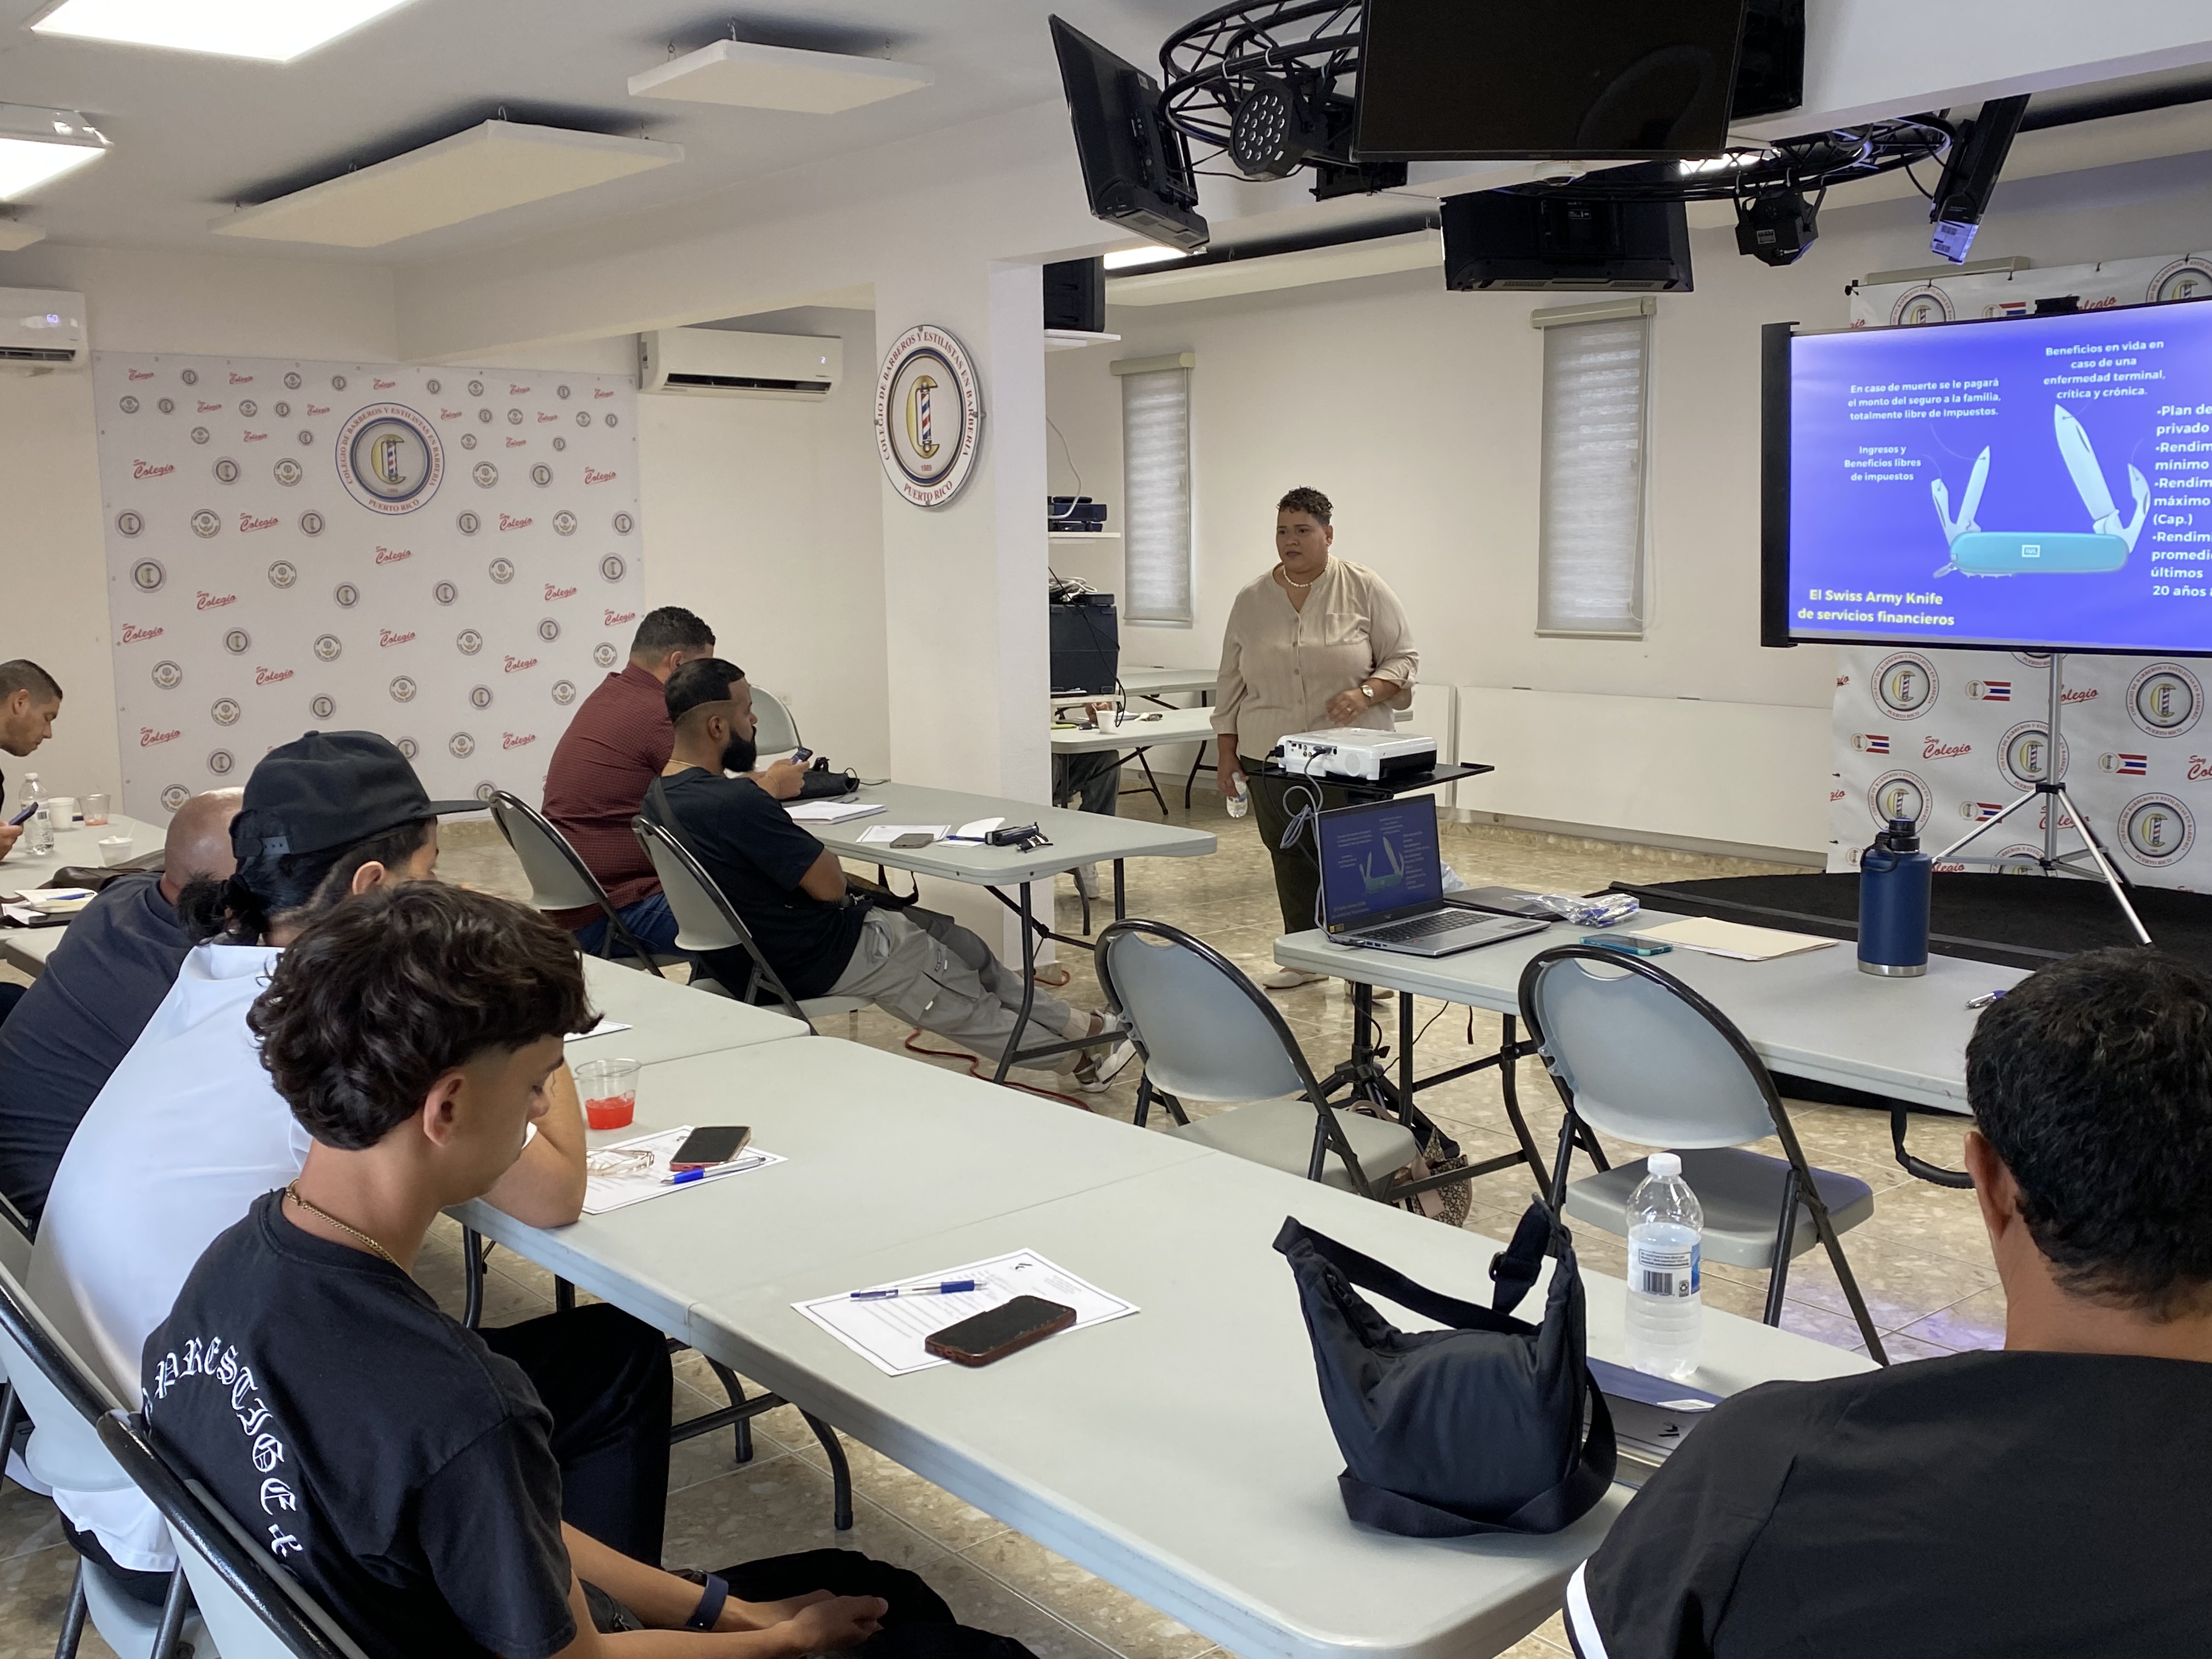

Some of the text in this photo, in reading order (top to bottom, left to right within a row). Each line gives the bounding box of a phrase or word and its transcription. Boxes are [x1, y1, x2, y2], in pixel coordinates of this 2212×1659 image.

[2080, 296, 2117, 310] legio
[917, 332, 922, 341] Y
[924, 331, 963, 369] ESTILISTAS
[2046, 345, 2102, 356] Beneficios
[2105, 344, 2119, 352] en
[2123, 341, 2146, 351] vida
[884, 334, 916, 381] BARBEROS
[2098, 358, 2112, 368] de
[961, 370, 969, 387] EN
[1902, 382, 1937, 391] muerte
[1953, 380, 1961, 388] le
[1964, 377, 1999, 390] pagará
[2044, 370, 2166, 385] enfermedad terminal,
[879, 385, 887, 400] DE
[1848, 398, 1856, 407] el
[1859, 398, 1889, 407] monto
[1892, 397, 1906, 405] del
[1909, 396, 1942, 406] seguro
[1952, 394, 1961, 403] la
[1963, 392, 2001, 403] familia,
[2057, 386, 2148, 399] crítica y crónica.
[1850, 408, 1999, 420] totalmente libre de impuestos.
[2196, 404, 2212, 414] de
[347, 408, 382, 435] BARBEROS
[391, 408, 429, 435] ESTILISTAS
[878, 402, 890, 460] COLEGIO
[2157, 422, 2209, 437] privado
[341, 435, 350, 445] DE
[428, 435, 436, 445] EN
[1859, 446, 1906, 455] Ingresos y
[134, 464, 174, 478] Colegio
[340, 447, 353, 484] COLEGIO
[2155, 459, 2209, 470] mínimo
[585, 472, 616, 484] Colegio
[1864, 472, 1914, 482] impuestos
[904, 481, 952, 503] PUERTO RICO
[369, 499, 419, 511] PUERTO RICO
[2154, 495, 2210, 506] máximo
[240, 517, 279, 532] Colegio
[500, 517, 532, 531] Colegio
[2153, 514, 2192, 526] (Cap.)
[376, 549, 411, 564] Colegio
[2152, 550, 2212, 561] promedi
[2151, 567, 2203, 578] últimos
[545, 586, 577, 601] Colegio
[1810, 589, 1943, 606] El Swiss Army Knife
[2153, 585, 2206, 596] 20 años
[197, 594, 236, 610] Colegio
[605, 612, 635, 625] Colegio
[1798, 608, 1955, 625] de servicios financieros
[123, 628, 163, 642] Colegio
[380, 631, 416, 646] Colegio
[505, 658, 537, 672] Colegio
[256, 669, 294, 685] Colegio
[2061, 688, 2098, 702] olegio
[140, 730, 180, 746] Colegio
[503, 734, 535, 749] Colegio
[1923, 744, 1971, 759] Colegio
[2189, 755, 2206, 764] Soy
[155, 1337, 296, 1515] PRESTIGE
